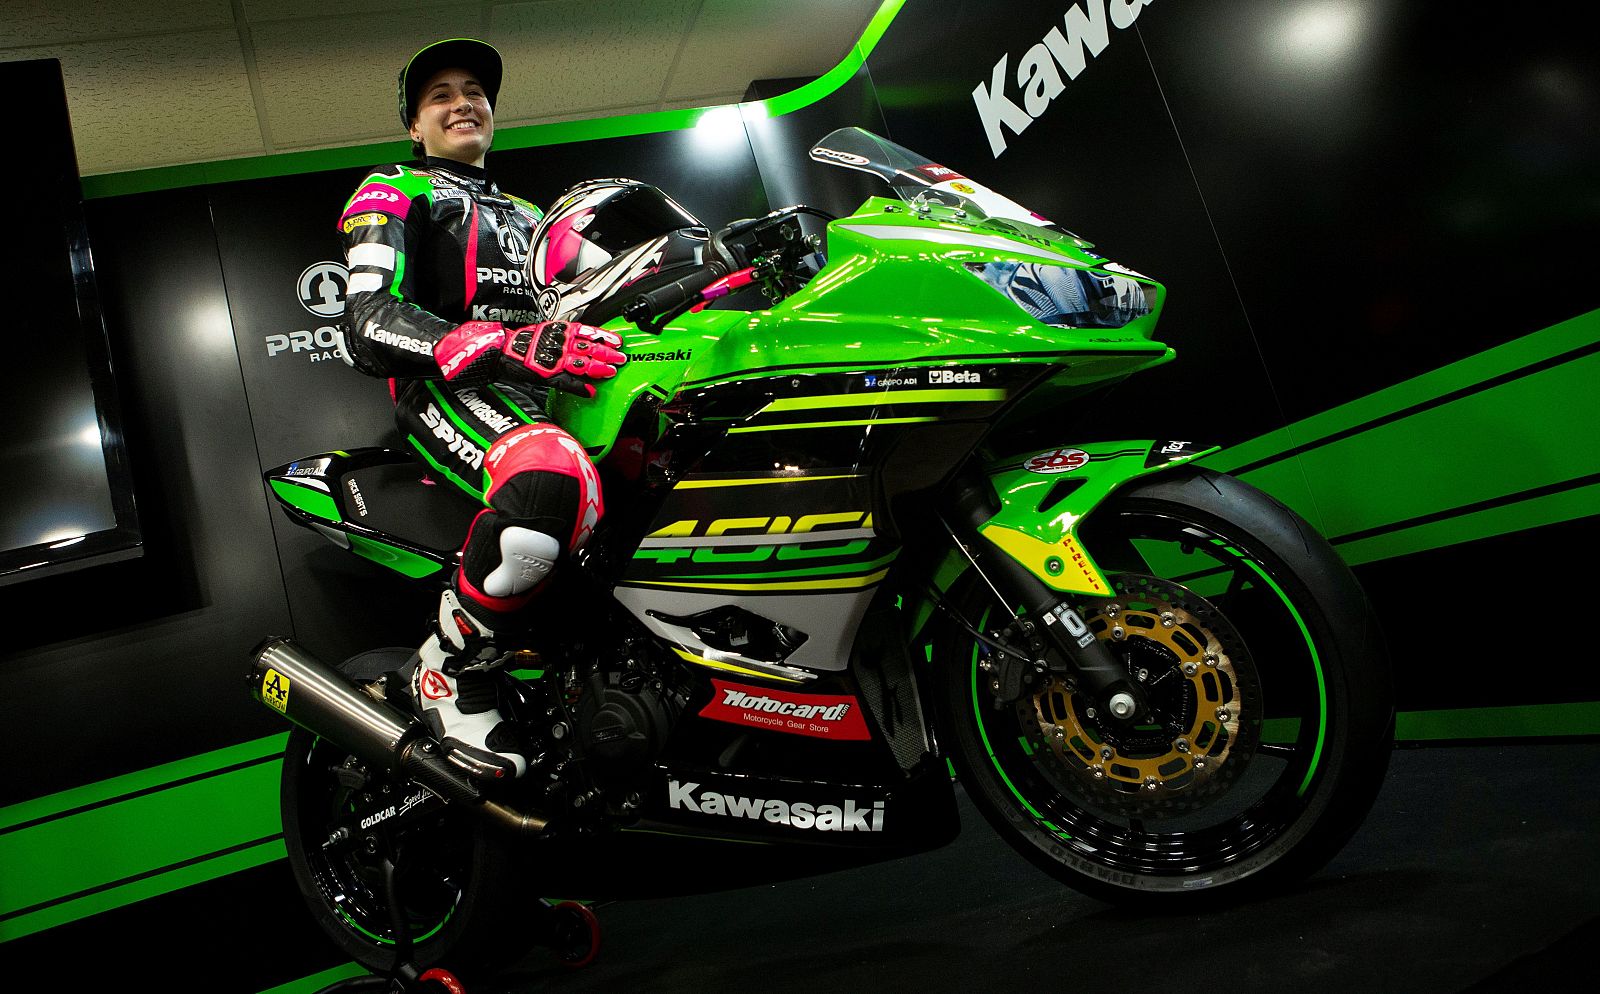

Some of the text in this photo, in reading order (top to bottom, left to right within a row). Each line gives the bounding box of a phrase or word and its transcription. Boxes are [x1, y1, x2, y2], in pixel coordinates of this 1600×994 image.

[265, 325, 340, 357] PRO
[364, 321, 438, 357] Kawasa
[309, 349, 342, 363] RAC
[626, 349, 692, 363] awasaki
[877, 377, 918, 387] GRUPO ADI
[942, 370, 981, 384] Beta
[454, 388, 519, 435] Kawasaki
[1028, 449, 1086, 469] sbs
[353, 492, 368, 517] SEATS
[1062, 538, 1100, 590] PIRELLI
[743, 712, 829, 733] Motorcycle Gear Store
[360, 805, 397, 830] GOLDCAR
[668, 779, 885, 832] Kawasaki
